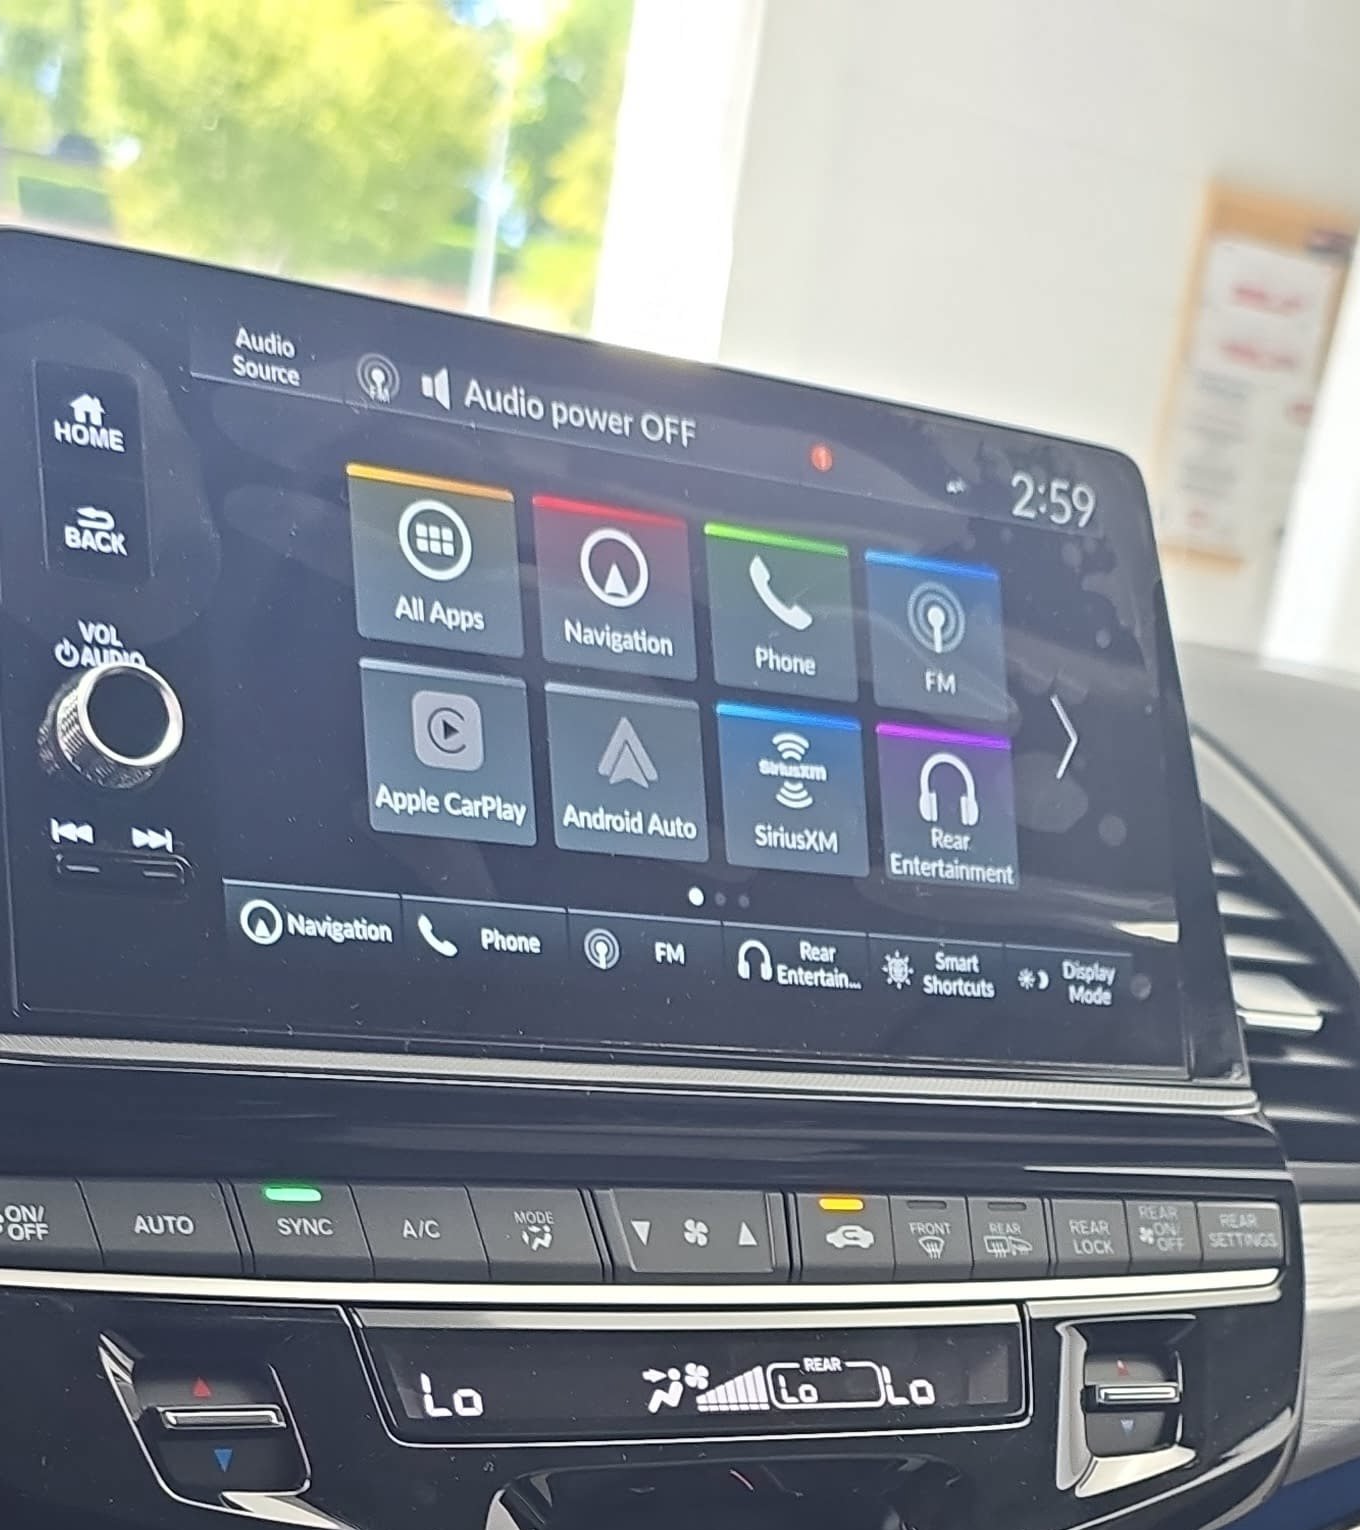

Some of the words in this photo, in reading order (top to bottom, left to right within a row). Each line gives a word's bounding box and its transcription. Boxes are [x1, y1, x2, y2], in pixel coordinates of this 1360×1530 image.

[235, 327, 296, 359] Audio
[232, 353, 300, 387] Source
[463, 378, 544, 420] Audio
[551, 400, 633, 438] power
[641, 413, 696, 447] OFF
[54, 421, 125, 453] HOME
[1010, 471, 1097, 529] 2:59
[64, 525, 128, 556] BACK
[395, 595, 423, 624] All
[430, 603, 486, 634] Apps
[77, 619, 124, 648] VOL
[563, 618, 674, 657] Navigation
[755, 646, 817, 677] Phone
[925, 671, 957, 695] FM
[375, 784, 440, 817] Apple
[444, 792, 527, 828] CarPlay
[562, 804, 643, 836] Android
[649, 812, 697, 840] Auto
[754, 824, 839, 855] SiriusXM
[930, 828, 971, 852] Rear
[890, 853, 1015, 886] Entertainment
[286, 913, 394, 944] Navigation
[480, 927, 541, 955] Phone
[654, 941, 686, 966] FM
[799, 940, 837, 964] Rear
[934, 951, 980, 975] Smart
[776, 963, 863, 992] Entertain...
[922, 973, 996, 999] Shortcuts
[1061, 959, 1117, 988] Display
[1068, 984, 1113, 1008] Mode
[4, 1203, 47, 1224] ON/
[134, 1214, 195, 1236] AUTO
[513, 1208, 556, 1226] MODE
[1138, 1203, 1179, 1221] REAR
[1218, 1212, 1259, 1230] REAR
[7, 1221, 50, 1242] OFF
[277, 1215, 334, 1237] SYNC
[401, 1217, 441, 1240] A/C
[908, 1220, 952, 1238] FRONT
[987, 1221, 1022, 1236] REAR
[1068, 1217, 1111, 1238] REAR
[1071, 1235, 1116, 1256] LOCK
[1155, 1234, 1186, 1253] OFF
[1207, 1230, 1280, 1250] SETTINGS
[802, 1356, 842, 1374] REAR
[420, 1371, 484, 1418] Lo
[778, 1374, 818, 1404] Lo
[880, 1365, 936, 1406] Lo
